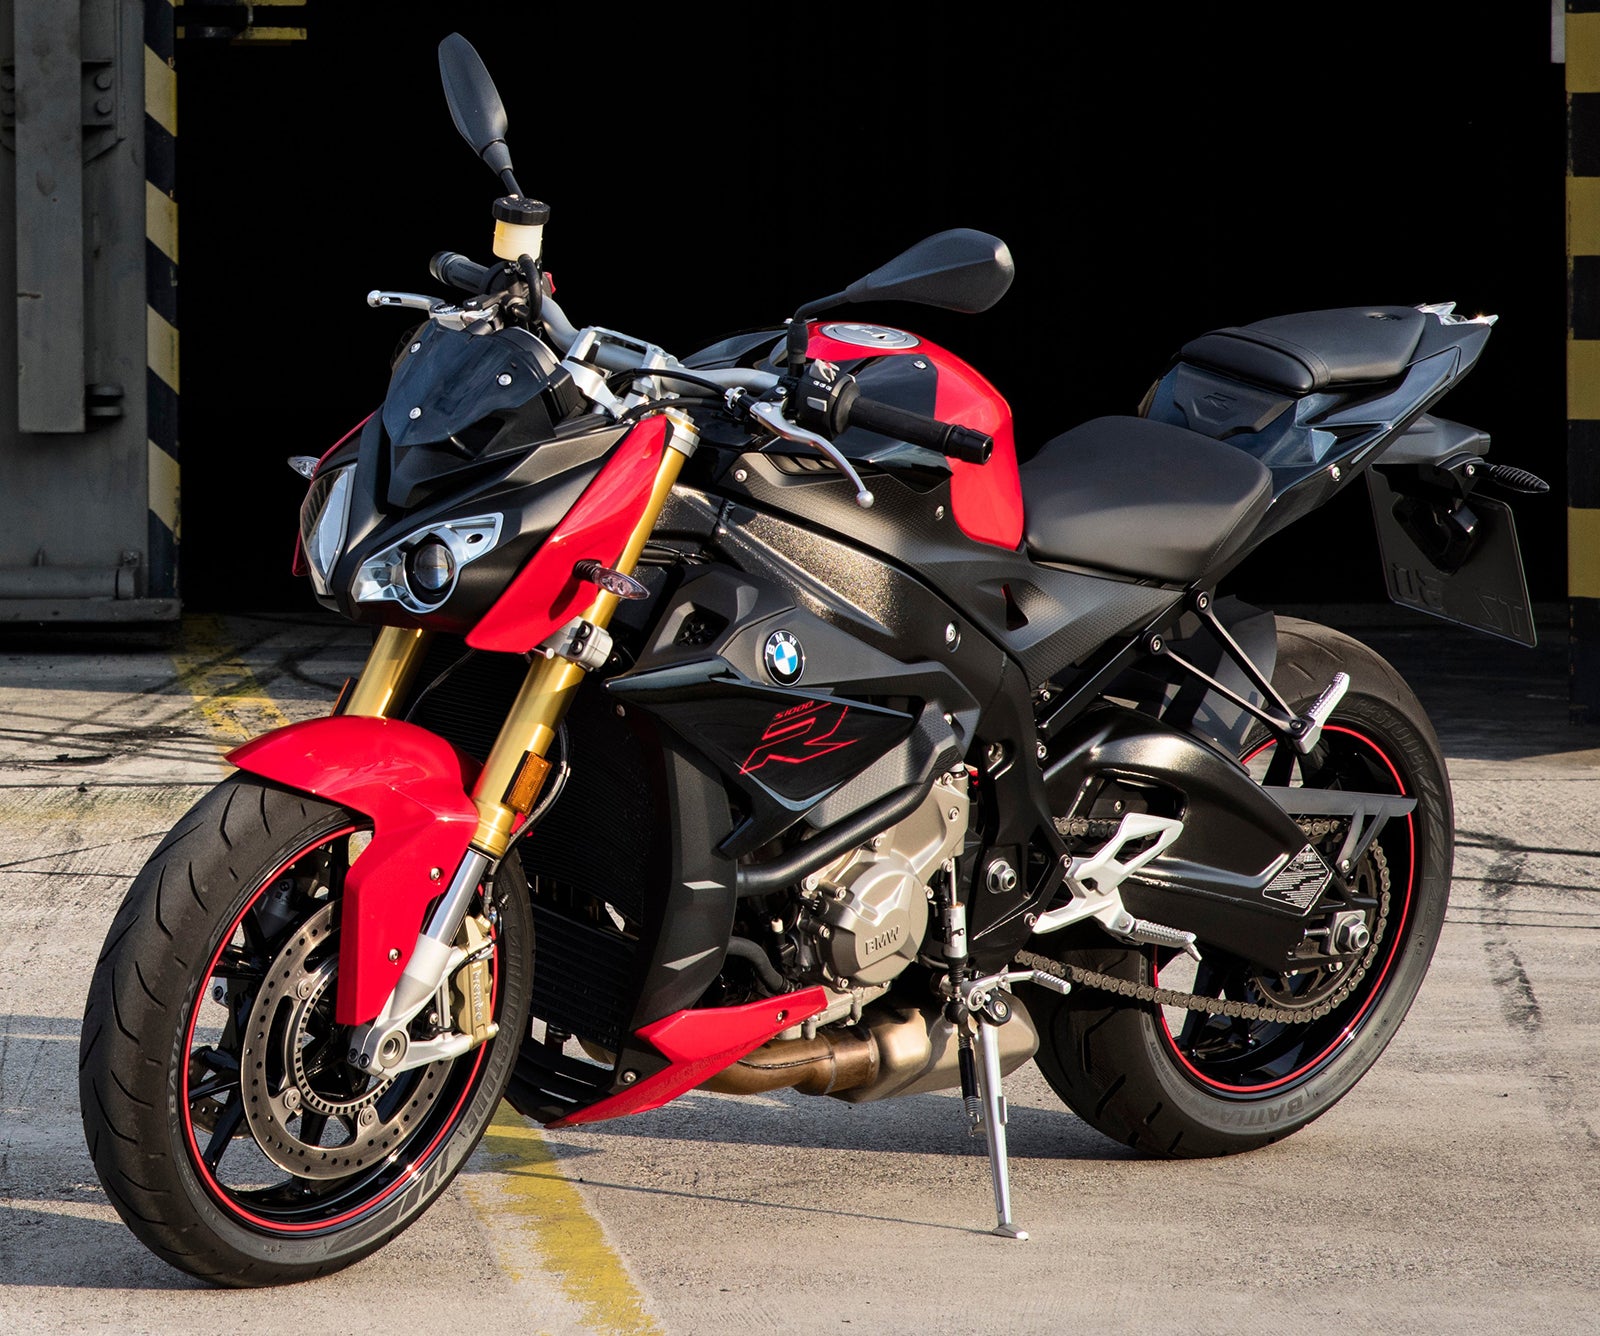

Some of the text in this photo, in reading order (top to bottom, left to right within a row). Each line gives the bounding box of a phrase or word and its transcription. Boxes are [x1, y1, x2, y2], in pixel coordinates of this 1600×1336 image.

[766, 632, 798, 655] BMW
[774, 700, 815, 719] S1000
[865, 924, 900, 955] BMW
